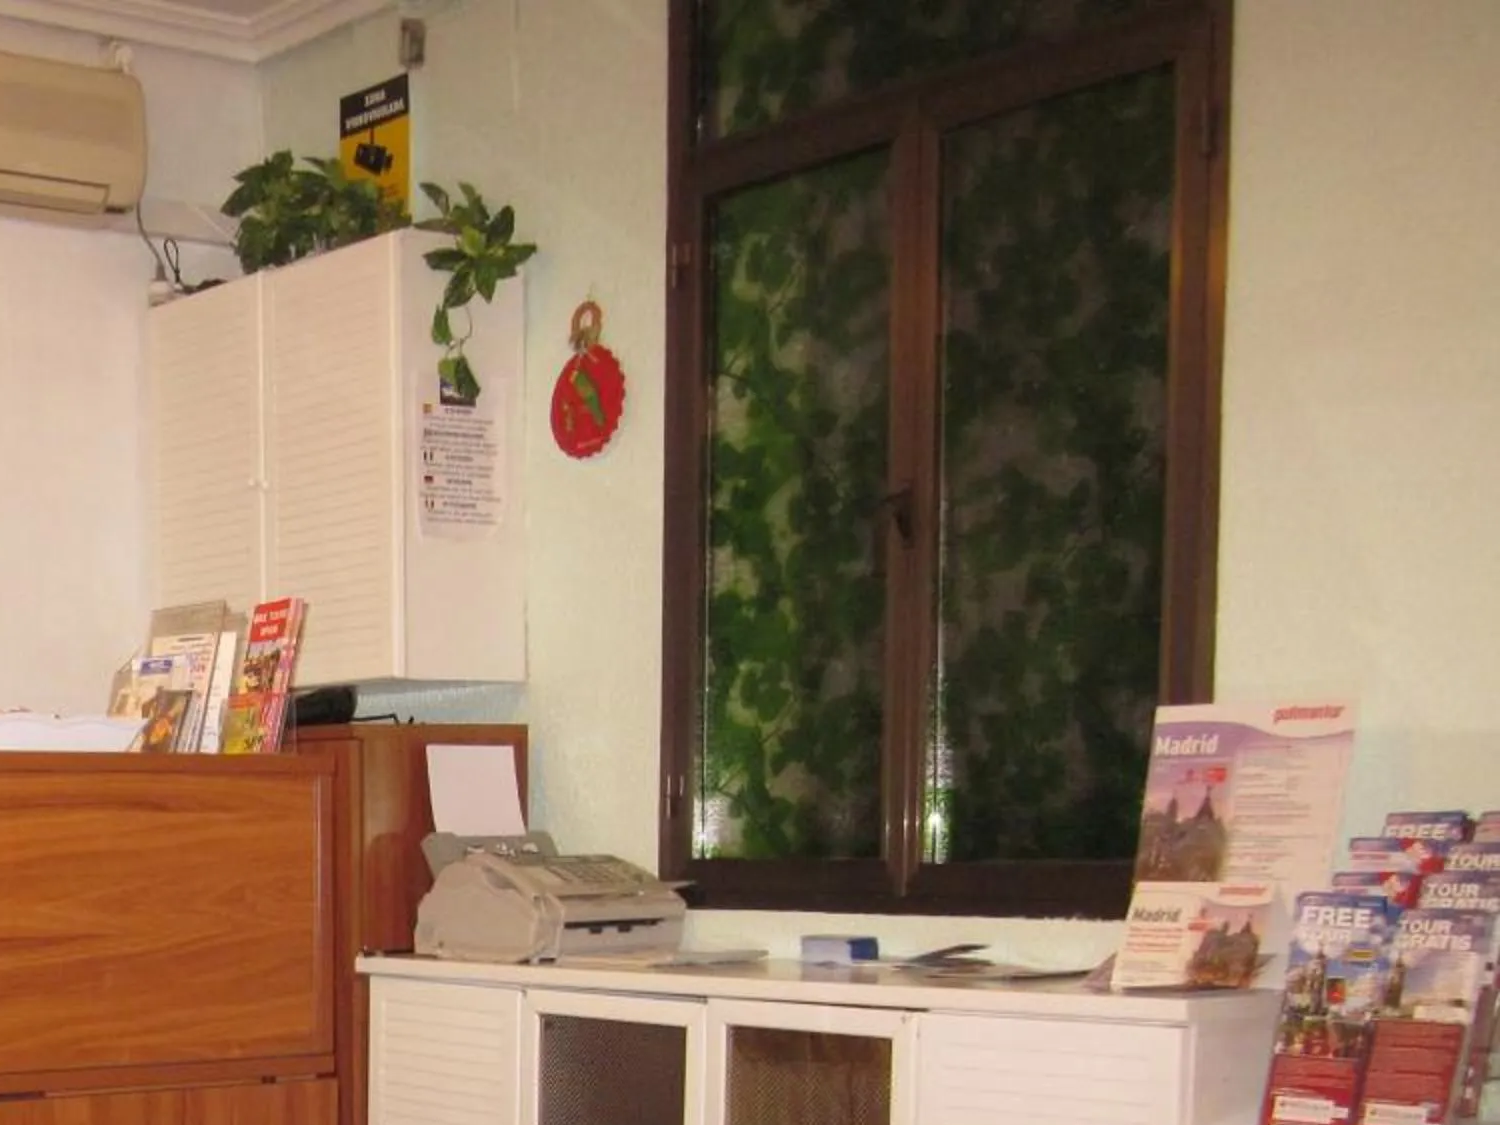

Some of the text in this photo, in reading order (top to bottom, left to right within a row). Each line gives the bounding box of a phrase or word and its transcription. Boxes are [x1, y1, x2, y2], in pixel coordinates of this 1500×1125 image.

[1155, 734, 1219, 755] Madrid
[1427, 883, 1481, 897] TOUR
[1133, 907, 1182, 922] Madrid
[1301, 905, 1373, 928] FREE
[1401, 919, 1453, 934] TOUR
[1394, 933, 1472, 950] GRATIS
